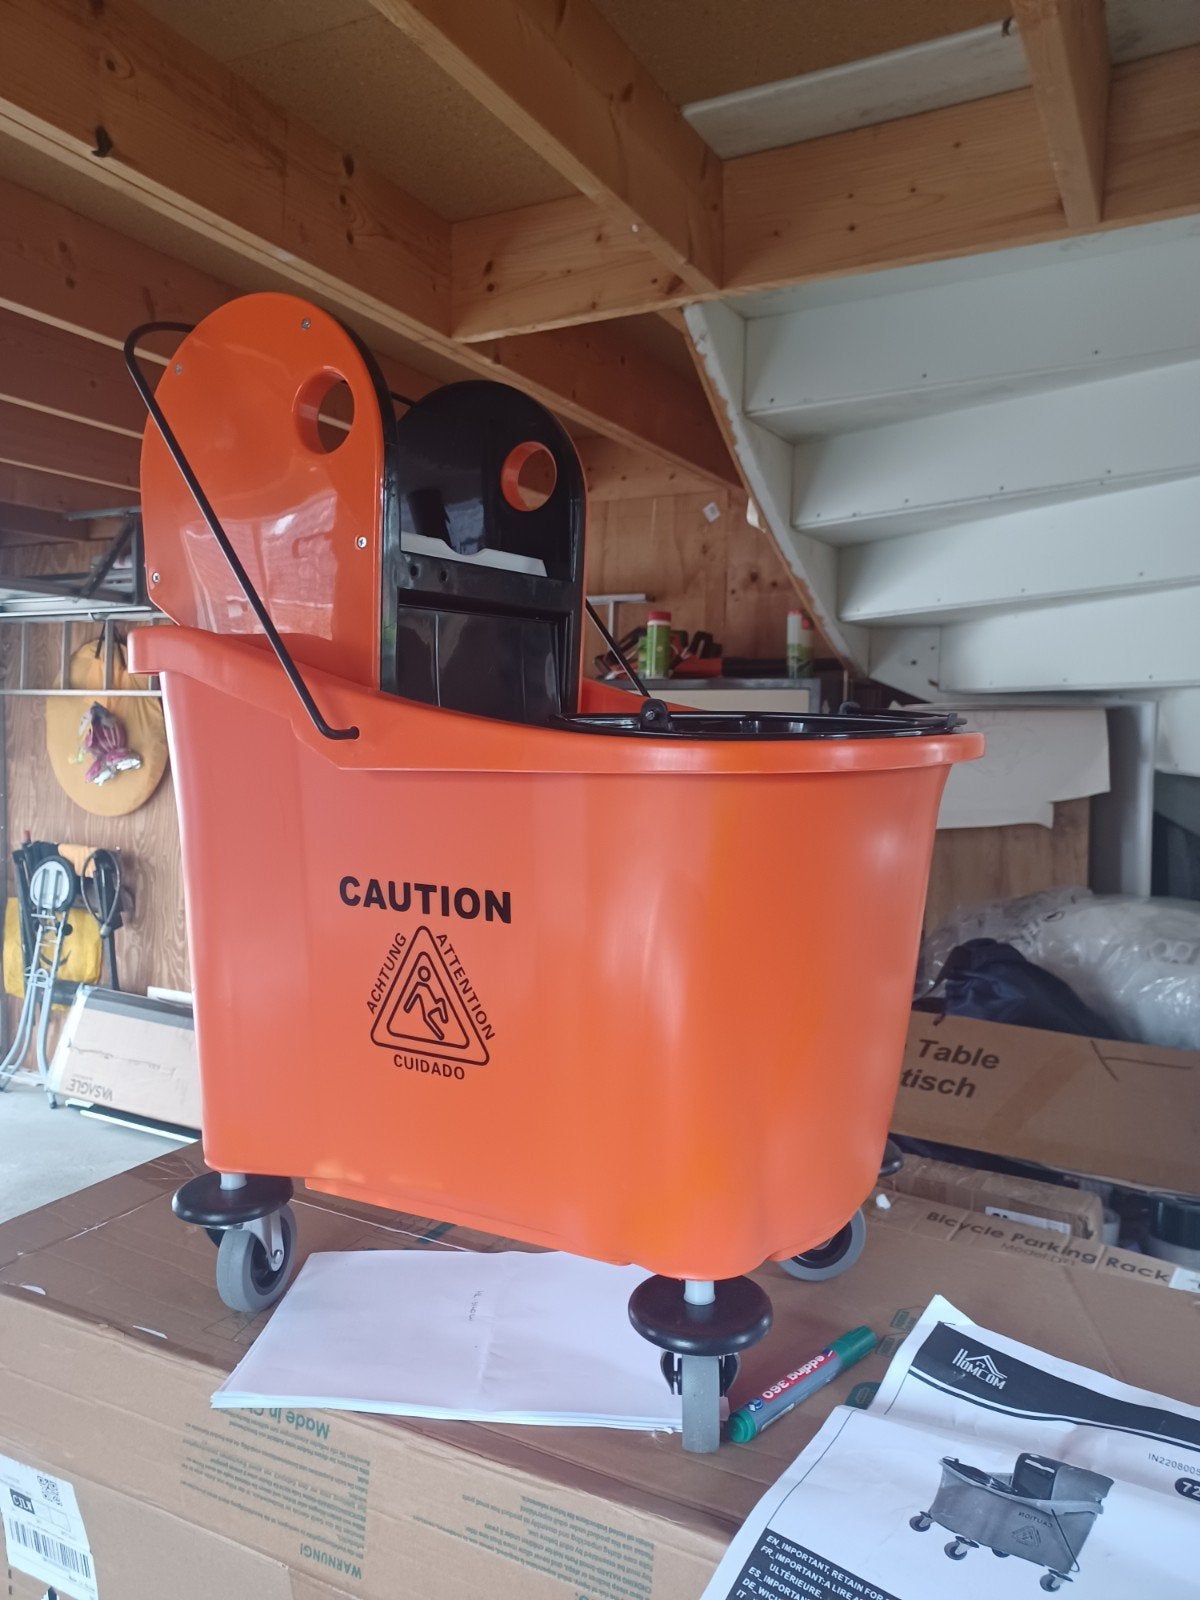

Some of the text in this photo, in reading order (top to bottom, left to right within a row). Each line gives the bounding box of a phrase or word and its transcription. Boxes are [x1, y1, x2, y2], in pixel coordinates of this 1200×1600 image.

[339, 876, 511, 924] CAUTION
[366, 932, 407, 1015] ACHTUNG
[436, 933, 496, 1041] ATTENTION
[394, 1054, 465, 1080] CUIDADO
[918, 1039, 1000, 1069] Table
[70, 1078, 113, 1101] VASAGLE
[926, 1211, 1169, 1283] Bicycle Parking Rack
[762, 1354, 825, 1399] edding 360
[269, 1408, 282, 1423] in
[286, 1411, 330, 1439] Made
[300, 1543, 362, 1579] WARNUNG!
[769, 1563, 822, 1599] ULTÉRIEURE.
[831, 1569, 864, 1592] RETAIN
[864, 1587, 884, 1600] FOR
[831, 1584, 853, 1600] LIRE
